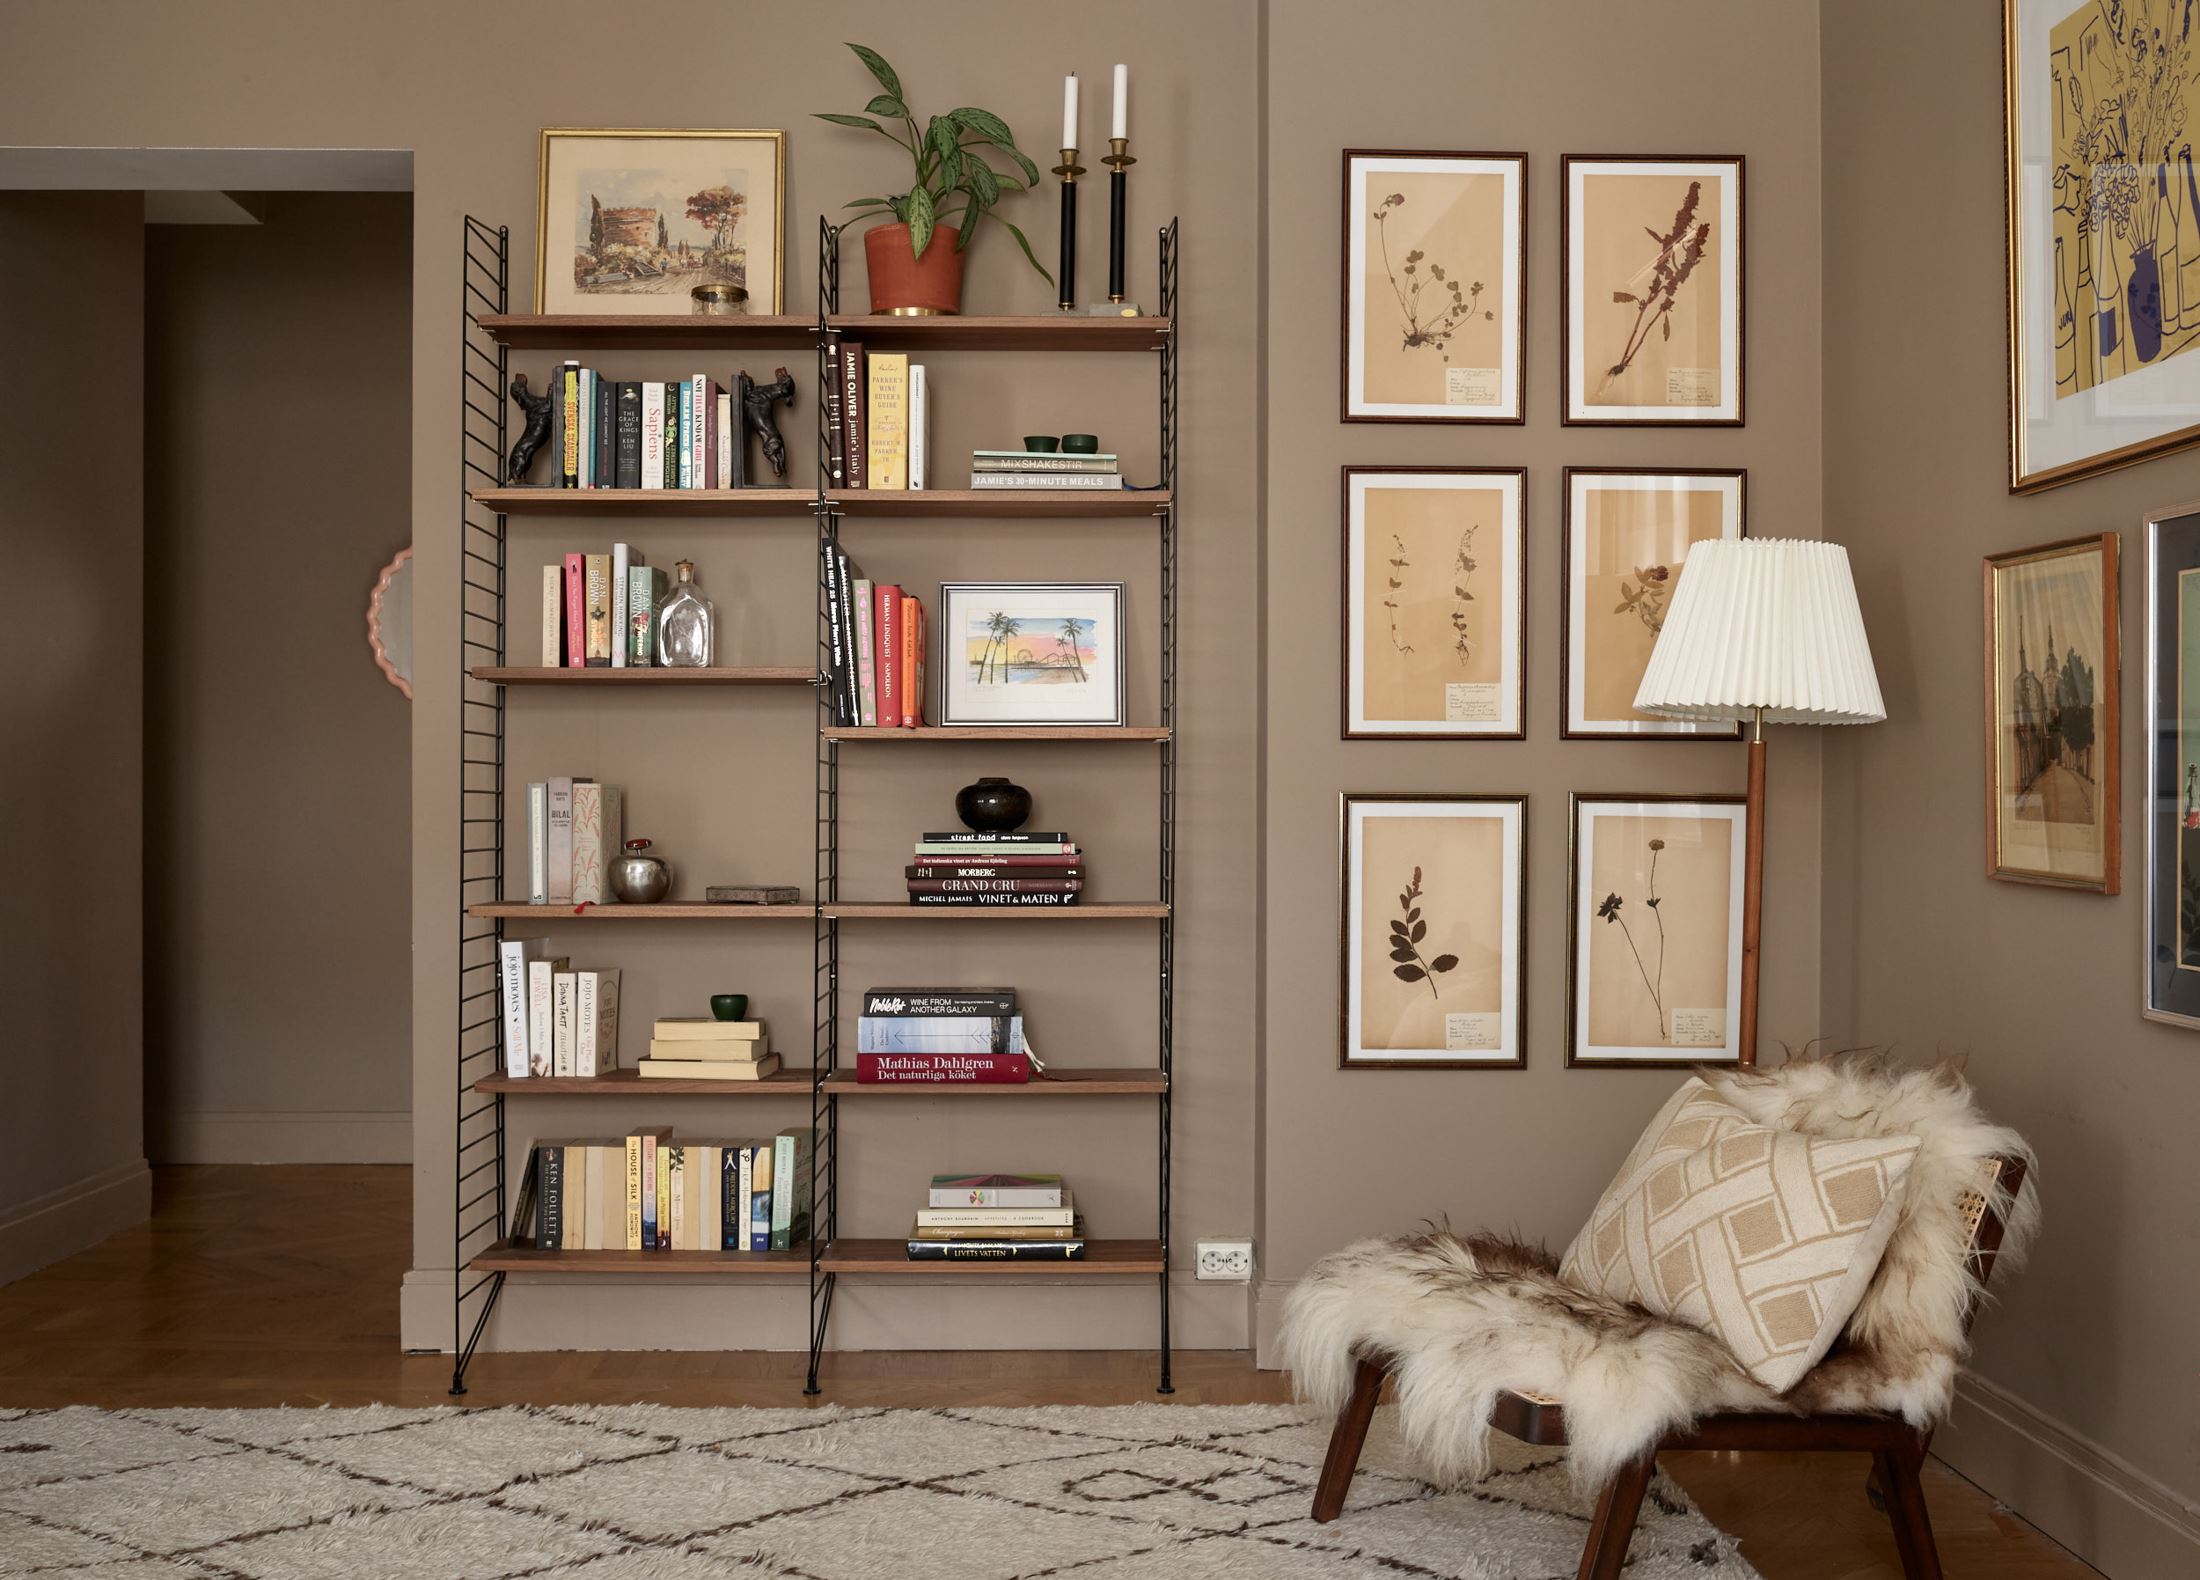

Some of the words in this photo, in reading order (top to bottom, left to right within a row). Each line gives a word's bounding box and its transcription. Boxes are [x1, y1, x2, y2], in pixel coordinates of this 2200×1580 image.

[847, 352, 856, 380] JAMIE
[848, 382, 857, 417] OLIVER
[566, 402, 576, 432] SVENSKA
[649, 408, 661, 460] Sapiens
[696, 435, 703, 444] OF
[848, 419, 859, 451] jamie's
[566, 434, 576, 472] SKANDALER
[850, 454, 860, 474] italy
[1000, 459, 1082, 469] MIXSHAKESTIR
[974, 476, 1014, 486] JAMIE'S
[1016, 476, 1067, 486] 30-MINUTE
[1070, 476, 1104, 486] MEALS
[590, 570, 599, 605] BROWN
[829, 590, 835, 599] 25
[633, 582, 642, 618] BROWN
[830, 602, 838, 623] Marco
[832, 625, 840, 645] Pierre
[551, 810, 571, 819] BILAL
[958, 868, 996, 876] MORBERG
[942, 880, 989, 891] GRAND
[992, 880, 1020, 891] CRU
[978, 894, 1012, 903] VINET
[1021, 894, 1058, 903] MATEN
[506, 954, 520, 976] jojo
[508, 978, 521, 1013] moyes
[559, 982, 569, 1005] DONNA
[583, 978, 592, 1000] JOJO
[560, 1006, 569, 1028] TARTT
[584, 1002, 592, 1033] MOYES
[877, 1057, 930, 1069] Mathias
[934, 1057, 993, 1071] Dahlgren
[877, 1071, 896, 1080] Det
[899, 1071, 945, 1081] naturliga
[949, 1070, 976, 1080] köket
[550, 1163, 558, 1184] KEN
[549, 1190, 557, 1236] FOLLETT
